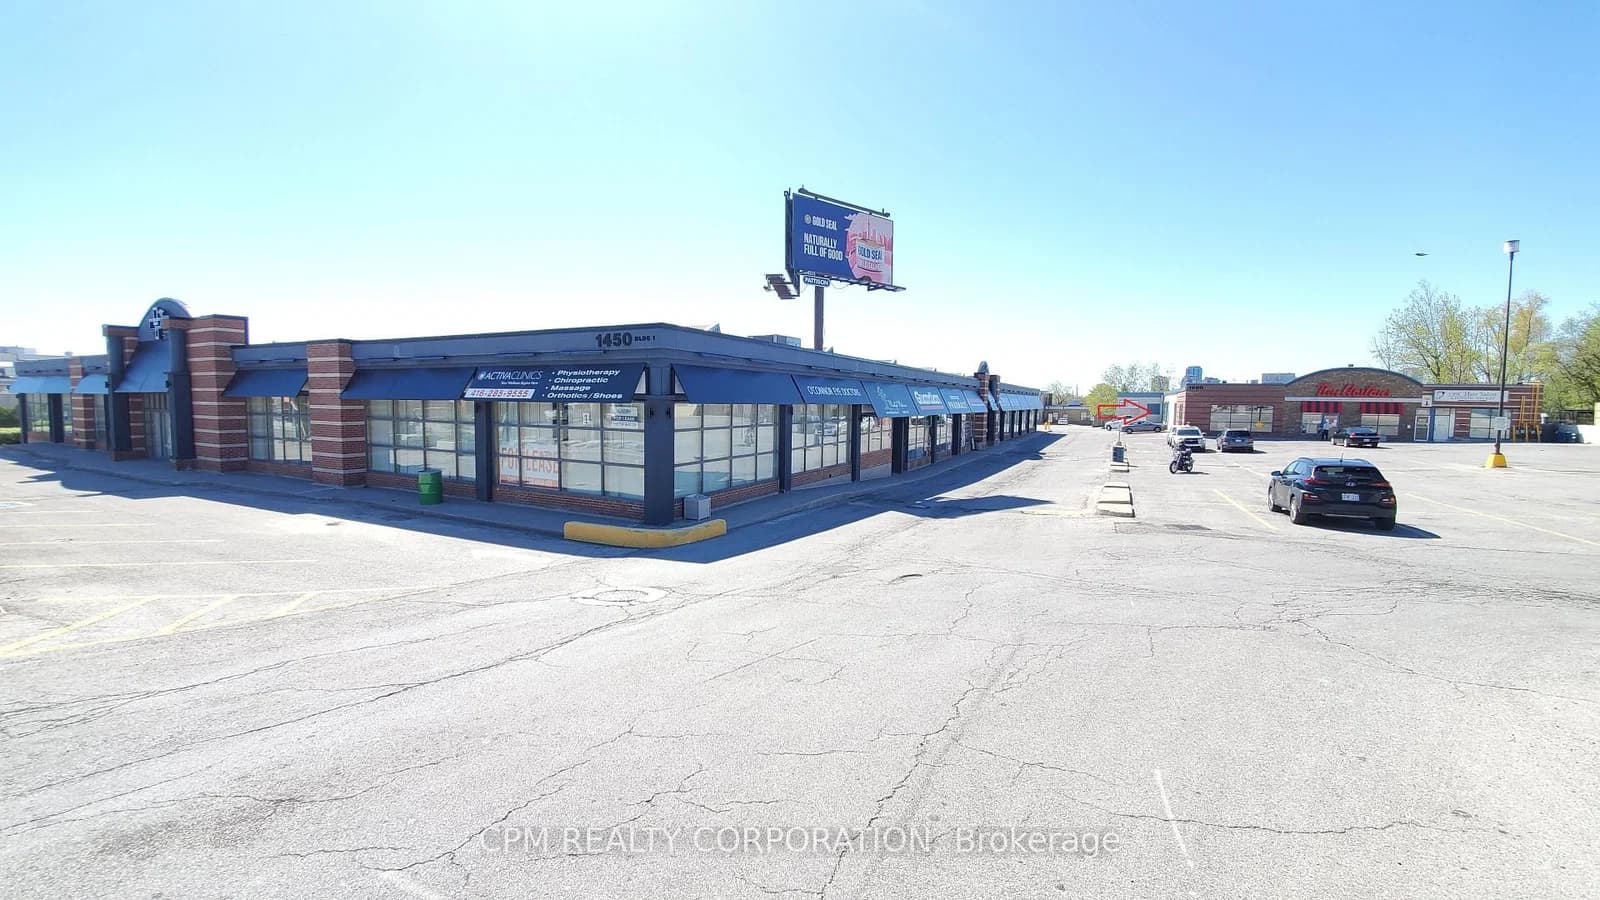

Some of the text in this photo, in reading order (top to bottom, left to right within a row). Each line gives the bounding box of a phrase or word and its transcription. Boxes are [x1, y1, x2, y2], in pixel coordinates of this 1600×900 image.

[812, 216, 837, 231] GOLD SEAL
[803, 232, 838, 249] NATURALLY
[803, 243, 843, 261] FULL OF GOOD
[858, 245, 871, 258] GOLD
[595, 332, 633, 348] 1450
[484, 370, 544, 380] ACTIVACLINICS
[557, 369, 621, 377] Physiotherapy
[501, 447, 519, 470] FO
